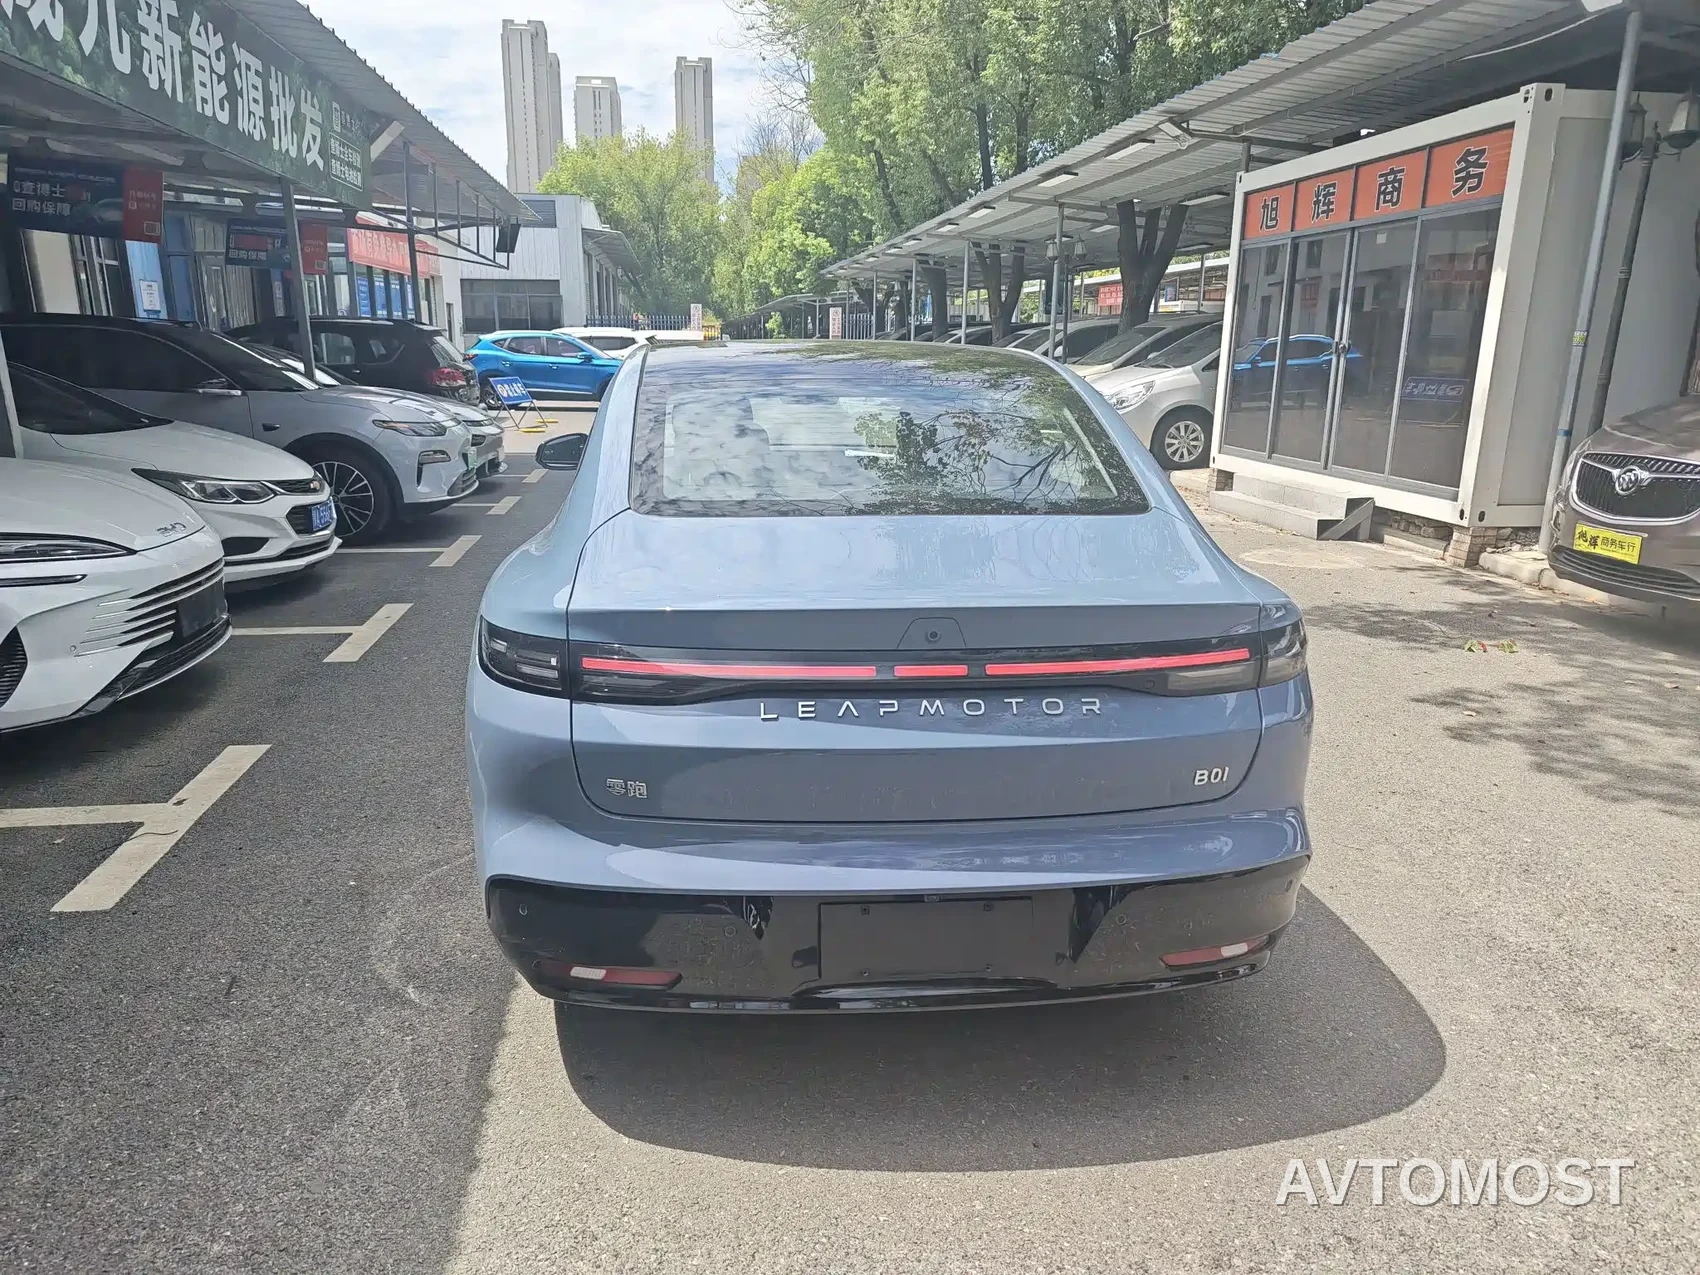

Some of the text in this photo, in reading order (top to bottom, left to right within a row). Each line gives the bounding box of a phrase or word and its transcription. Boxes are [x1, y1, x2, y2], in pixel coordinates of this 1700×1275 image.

[1259, 146, 1489, 232] 旭辉商务
[12, 198, 72, 217] 回购保障
[760, 697, 1102, 721] LEAPMOTOR
[606, 778, 648, 799] 零跑
